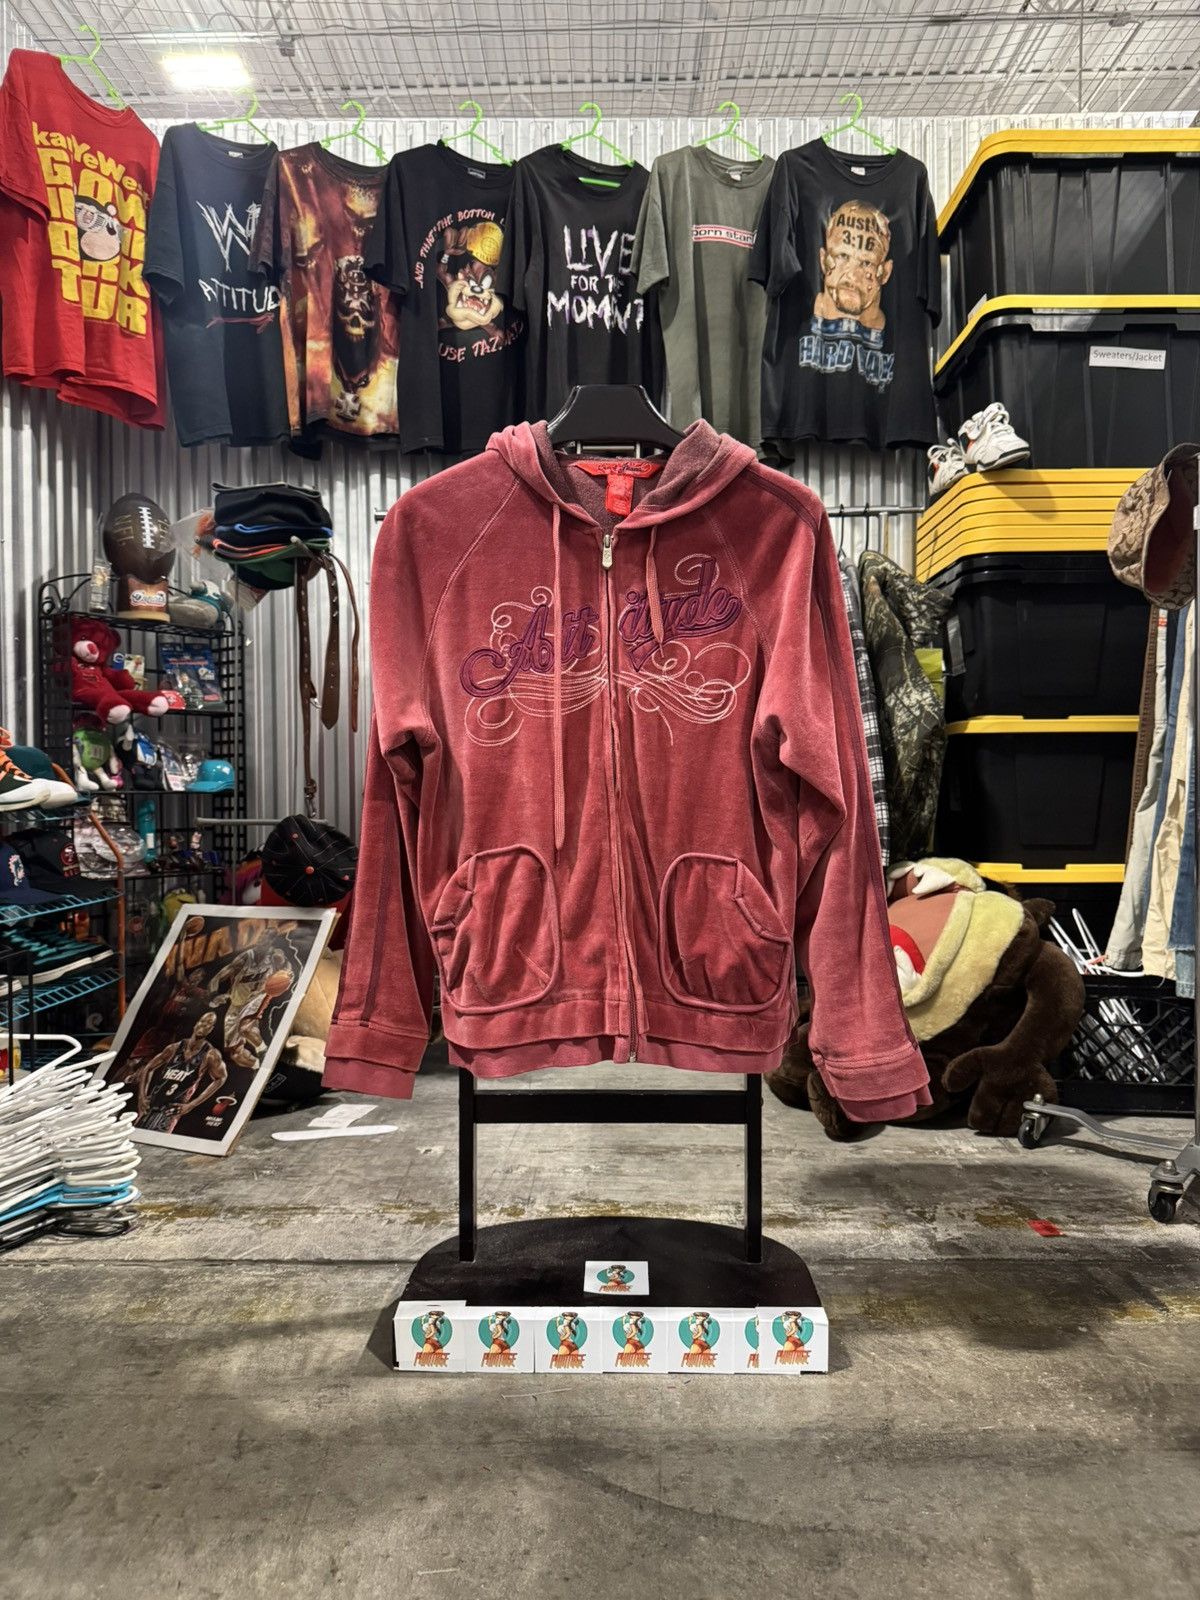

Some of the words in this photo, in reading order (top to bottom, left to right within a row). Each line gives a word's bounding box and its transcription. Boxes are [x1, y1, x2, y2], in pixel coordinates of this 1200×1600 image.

[457, 208, 496, 221] BOTTOM
[842, 229, 876, 251] 3:16
[563, 224, 636, 278] LIVE
[570, 275, 599, 294] FOR
[198, 277, 281, 314] ATTITUD
[163, 1068, 195, 1082] HEAT
[165, 1083, 179, 1096] 3
